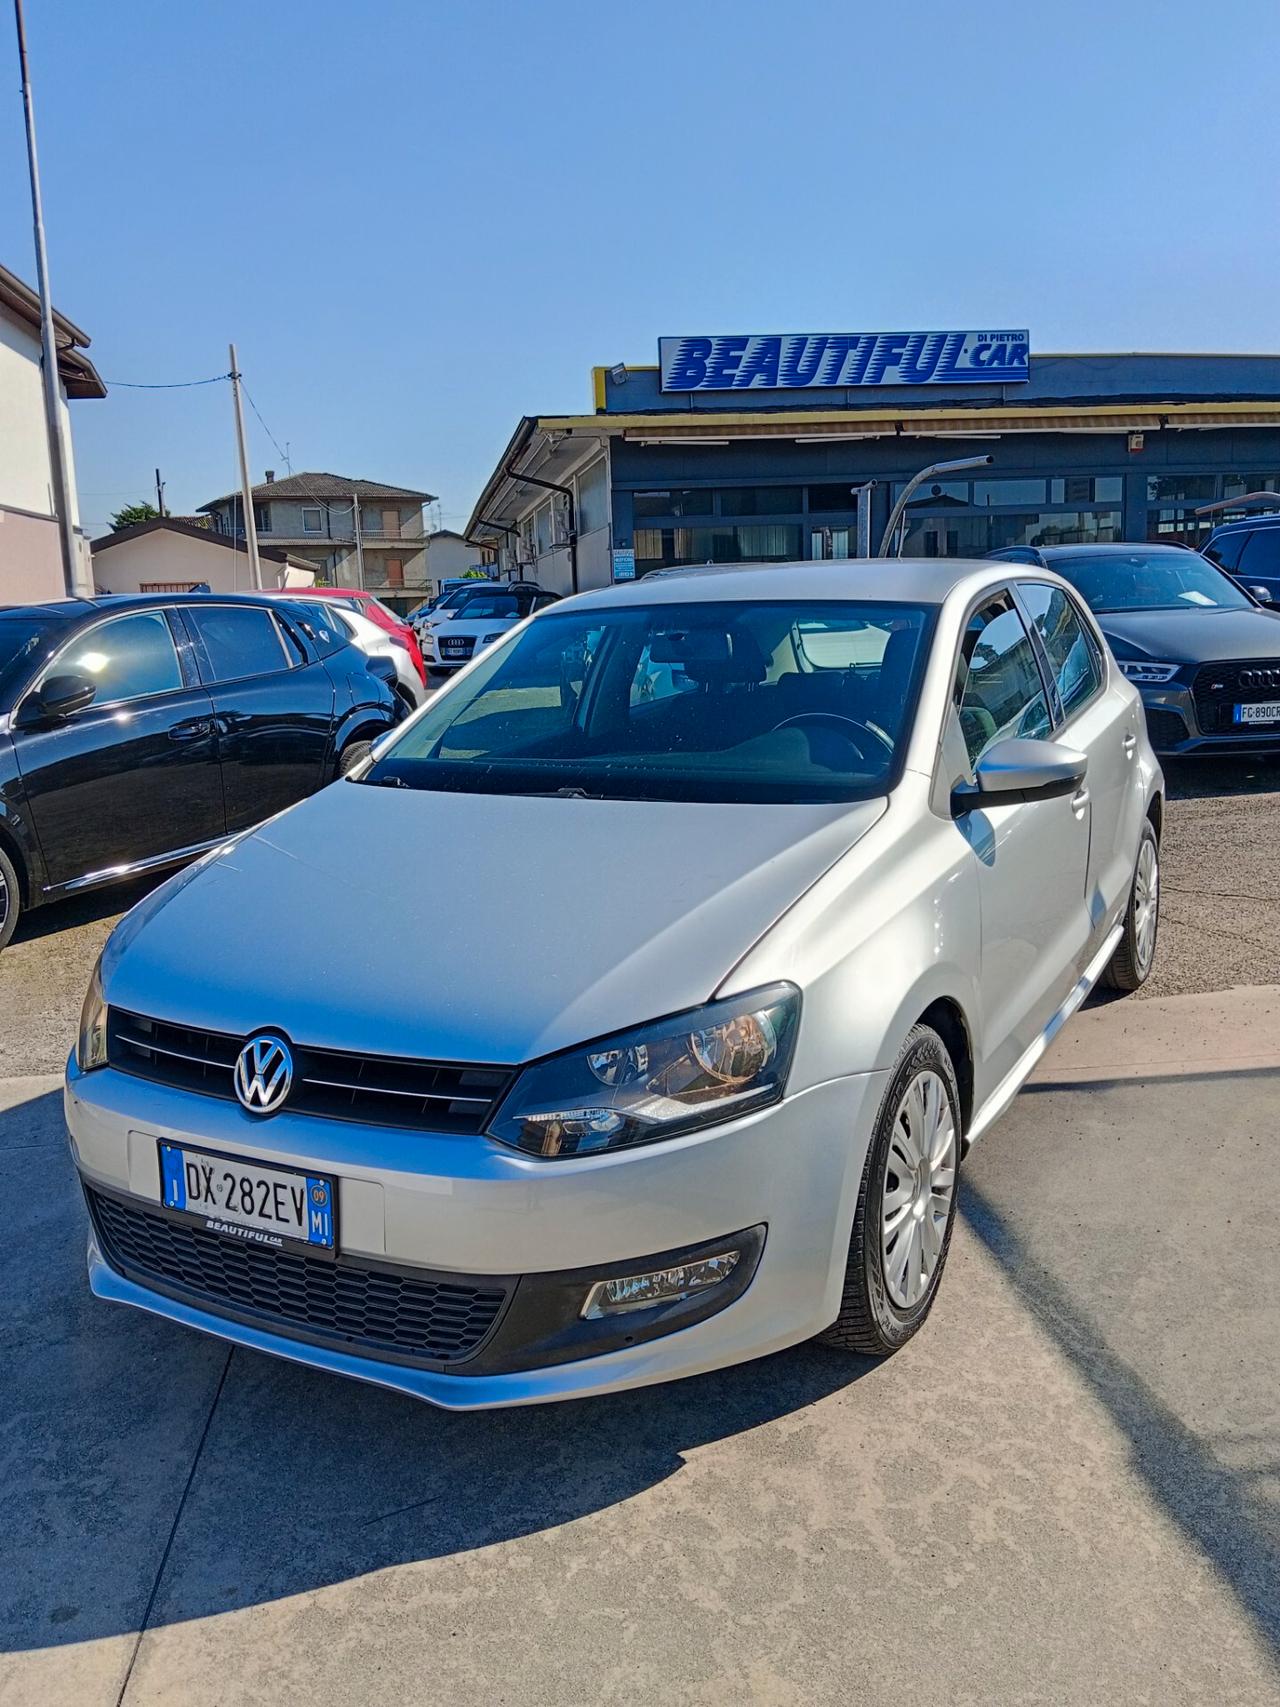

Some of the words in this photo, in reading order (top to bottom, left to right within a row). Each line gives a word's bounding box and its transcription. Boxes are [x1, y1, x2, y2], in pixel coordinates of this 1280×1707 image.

[978, 334, 988, 342] DI
[990, 333, 1024, 342] PIETRO
[664, 333, 968, 389] BEAUTIFUL
[969, 343, 1028, 367] CAR
[186, 1162, 217, 1205] DX
[222, 1172, 305, 1227] 282EV
[313, 1190, 325, 1202] 09
[206, 1220, 270, 1243] BEAUTIFUL
[312, 1210, 329, 1236] MI
